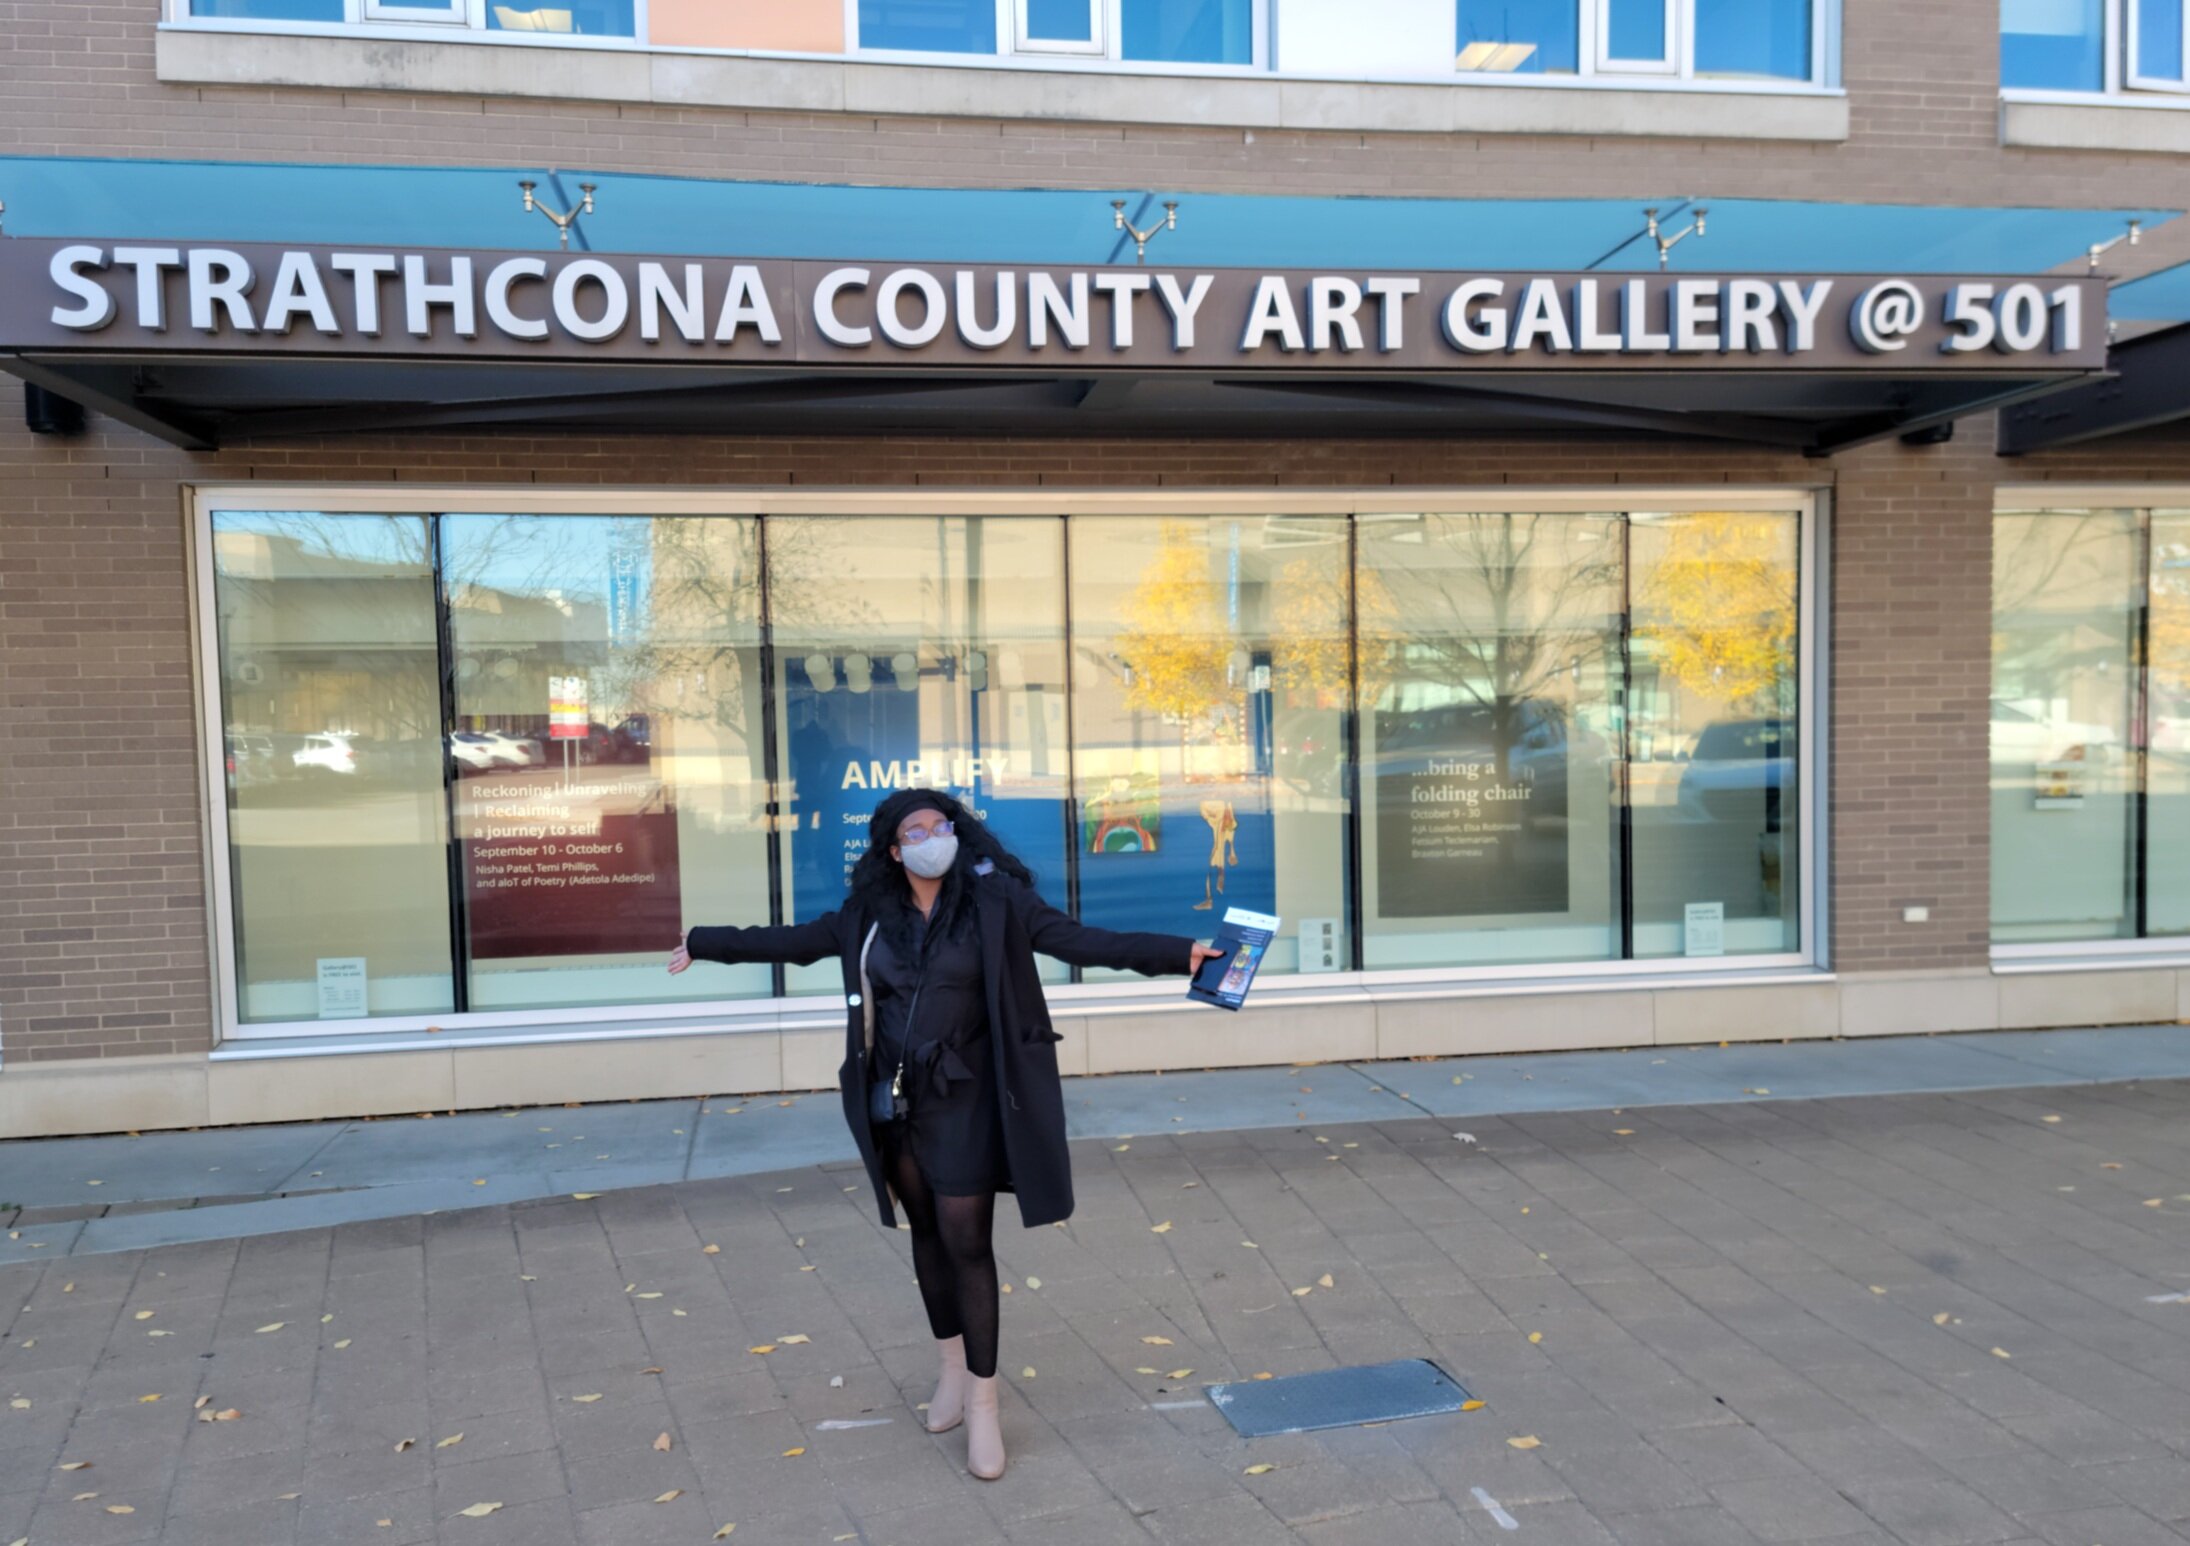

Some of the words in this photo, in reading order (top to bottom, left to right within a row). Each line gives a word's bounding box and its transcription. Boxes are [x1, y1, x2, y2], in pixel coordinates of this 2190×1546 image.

[50, 244, 782, 346] STRATHCONA
[812, 267, 1216, 352] COUNTY
[1238, 275, 1421, 353] ART
[1441, 278, 1834, 355] GALLERY
[1850, 279, 1924, 355] @
[1938, 282, 2083, 355] 501
[841, 758, 1008, 790] AMPLIFY
[1412, 758, 1480, 781] ...bring
[1485, 763, 1496, 775] a
[472, 784, 552, 800] Reckoning
[564, 782, 647, 798] Unraveling
[1411, 784, 1479, 807] folding
[1484, 783, 1532, 801] chair
[486, 803, 570, 819] Reclaiming
[1411, 808, 1451, 820] October
[1453, 808, 1460, 819] 9
[1467, 807, 1481, 818] 30
[474, 826, 483, 838] a
[486, 825, 546, 841] journey
[550, 824, 566, 836] to
[569, 822, 597, 836] self
[473, 844, 539, 860] September
[542, 844, 556, 856] 10
[566, 842, 613, 855] October
[615, 842, 623, 853] 6
[844, 839, 861, 850] AJA
[475, 864, 504, 875] Nisha
[506, 863, 534, 874] Patel,
[536, 862, 560, 873] Temi
[562, 862, 599, 874] Phillips,
[476, 878, 496, 888] and
[521, 876, 532, 886] of
[534, 876, 567, 888] Poetry
[569, 874, 610, 886] (Adetola
[612, 872, 656, 885] Adedipe)
